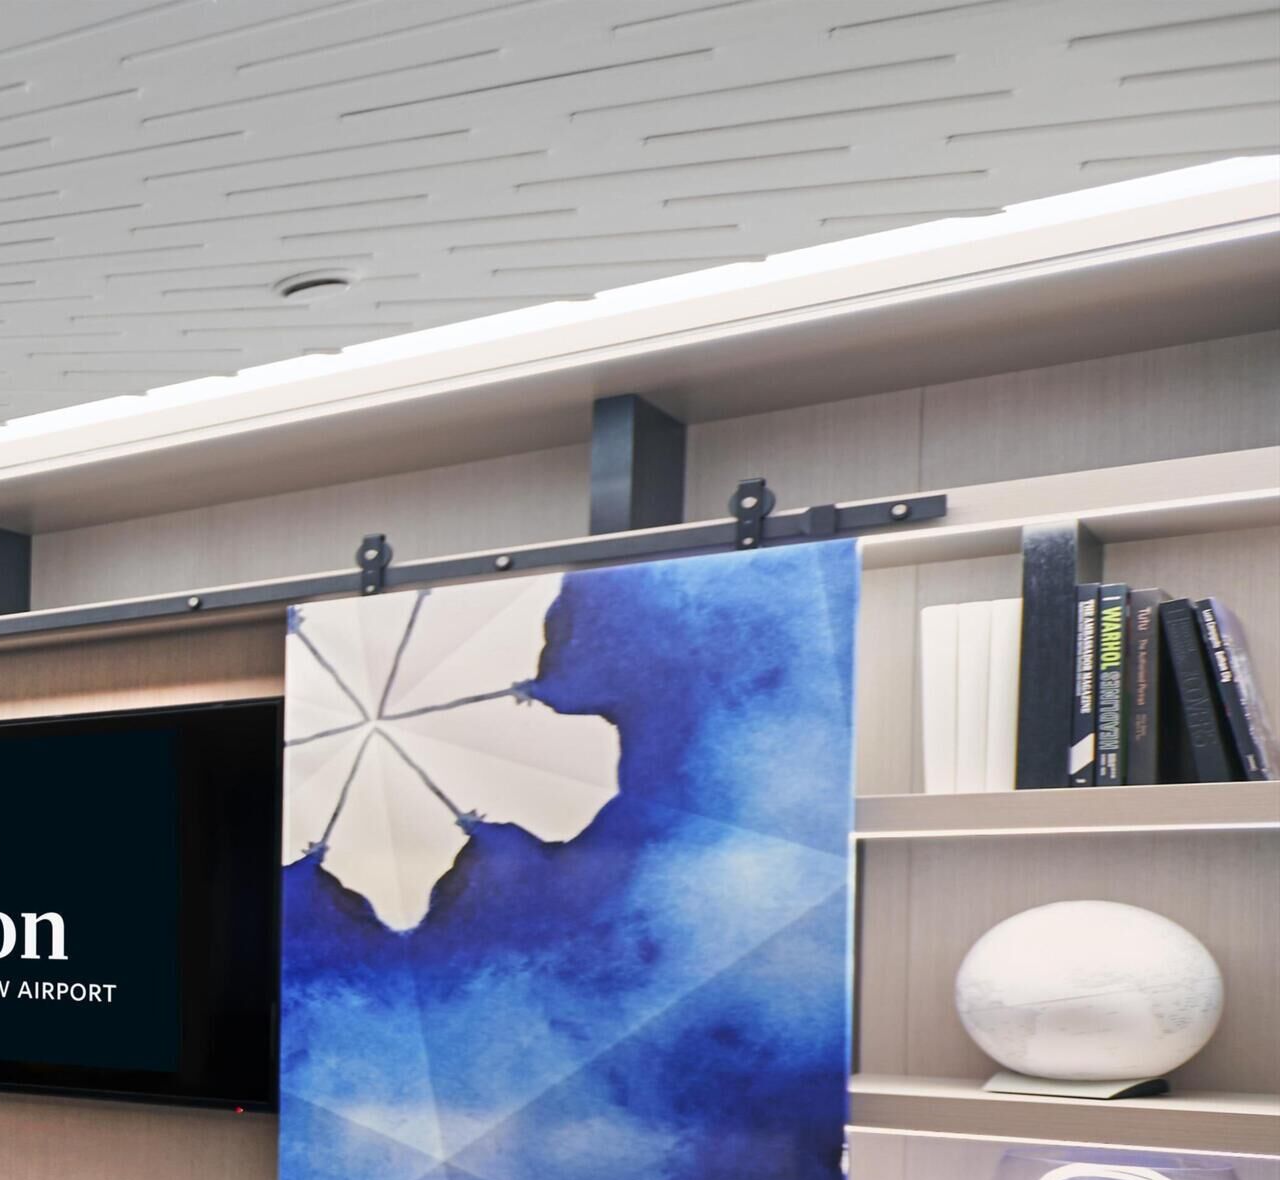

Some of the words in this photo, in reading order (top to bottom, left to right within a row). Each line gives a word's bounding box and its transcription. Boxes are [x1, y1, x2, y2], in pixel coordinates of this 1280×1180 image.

[1101, 606, 1122, 671] WARHOL
[1080, 673, 1093, 714] MAGAZINE
[17, 981, 117, 1003] AIRPORT
